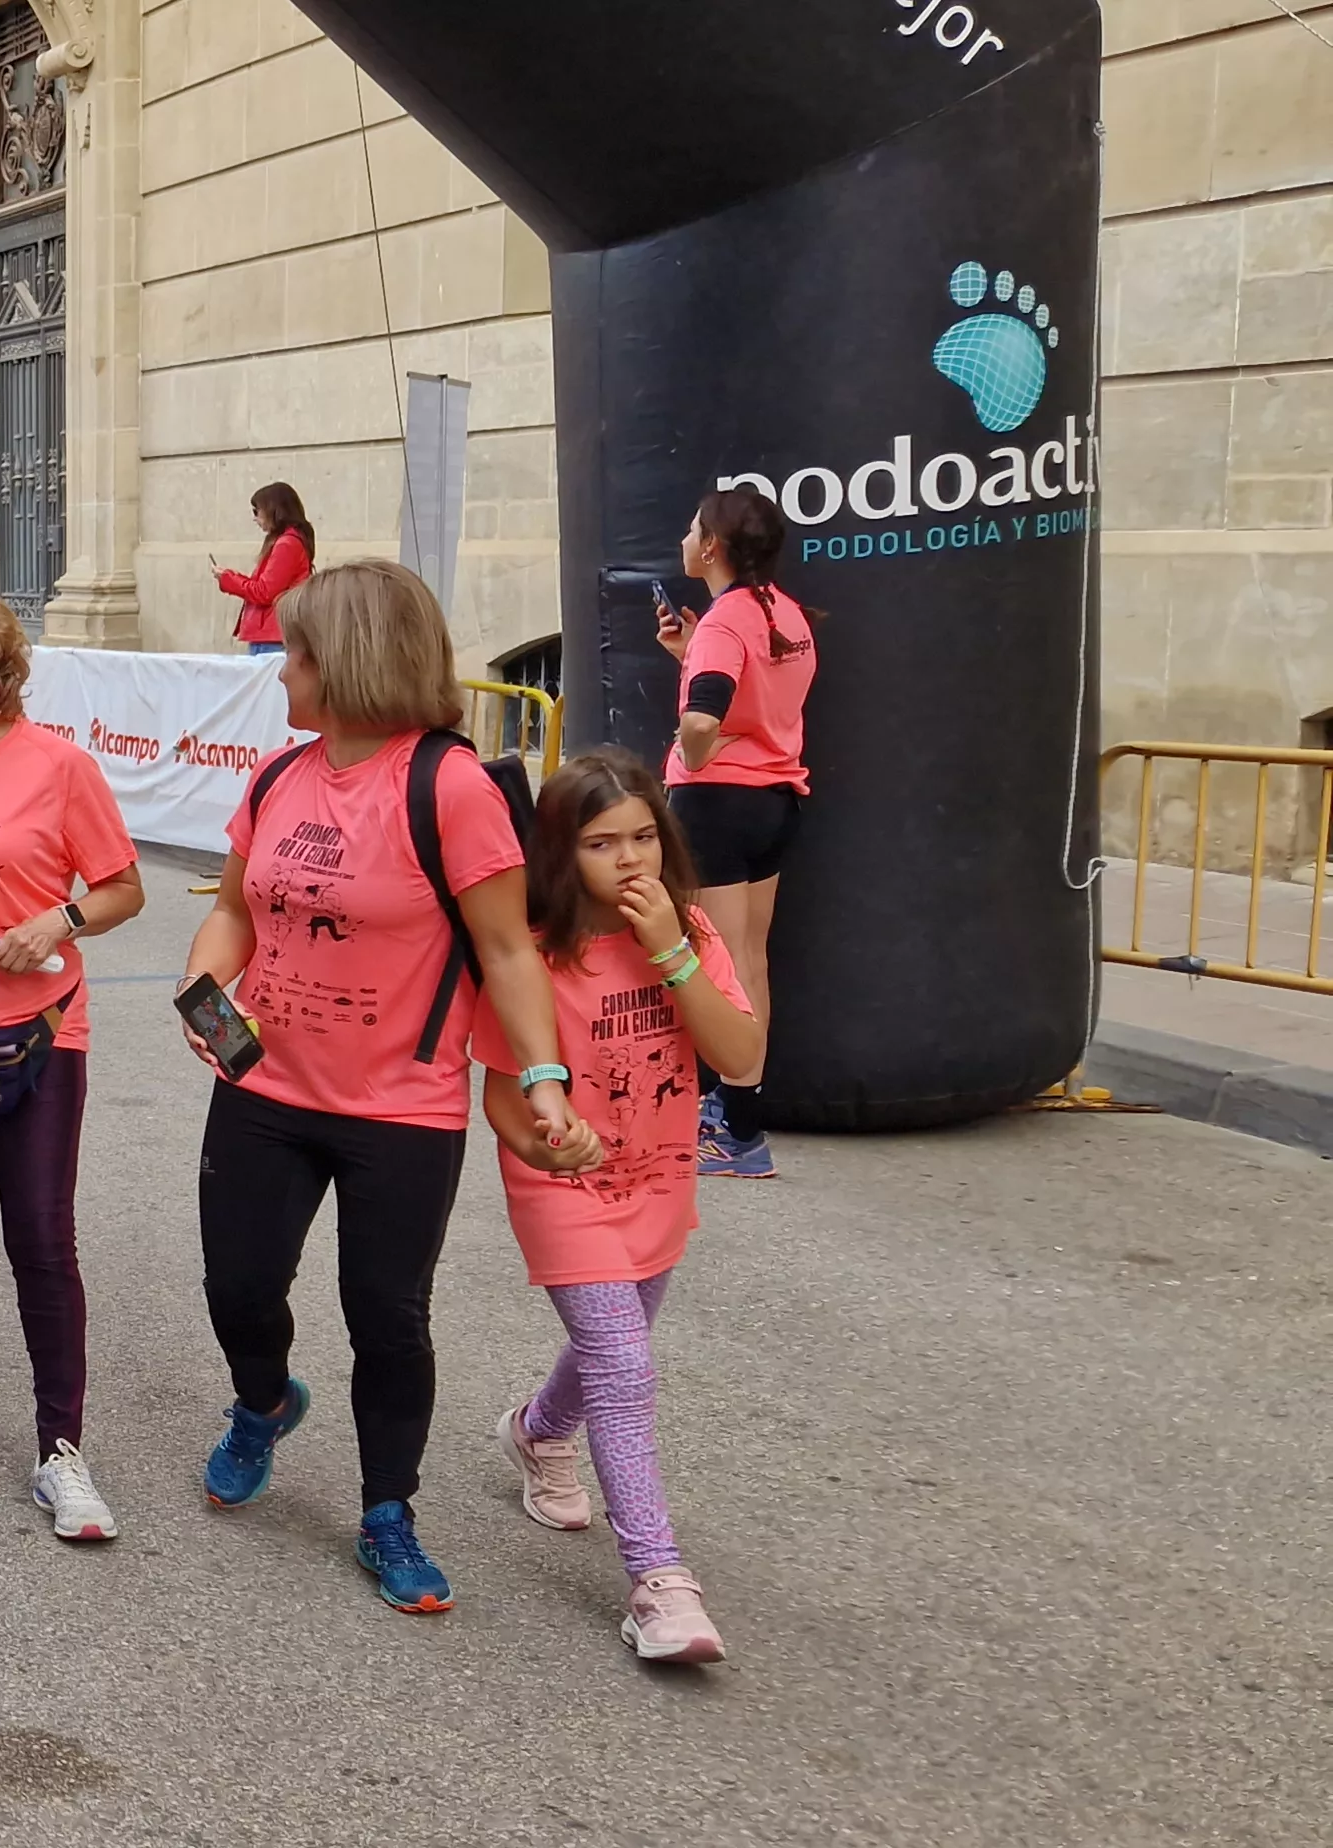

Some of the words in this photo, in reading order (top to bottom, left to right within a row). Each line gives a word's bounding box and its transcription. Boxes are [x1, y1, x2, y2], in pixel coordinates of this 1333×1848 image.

[802, 515, 1001, 563] PODOLOGÍA
[1013, 517, 1027, 540] Y
[88, 717, 160, 765] Alcampo
[292, 821, 343, 847] CORRAMOS
[273, 837, 298, 858] POR
[304, 845, 345, 869] CIENCIA
[601, 983, 665, 1017] CORRAMOS
[591, 1017, 614, 1042] POR
[617, 1014, 630, 1037] LA
[633, 1004, 675, 1034] CIENCIA
